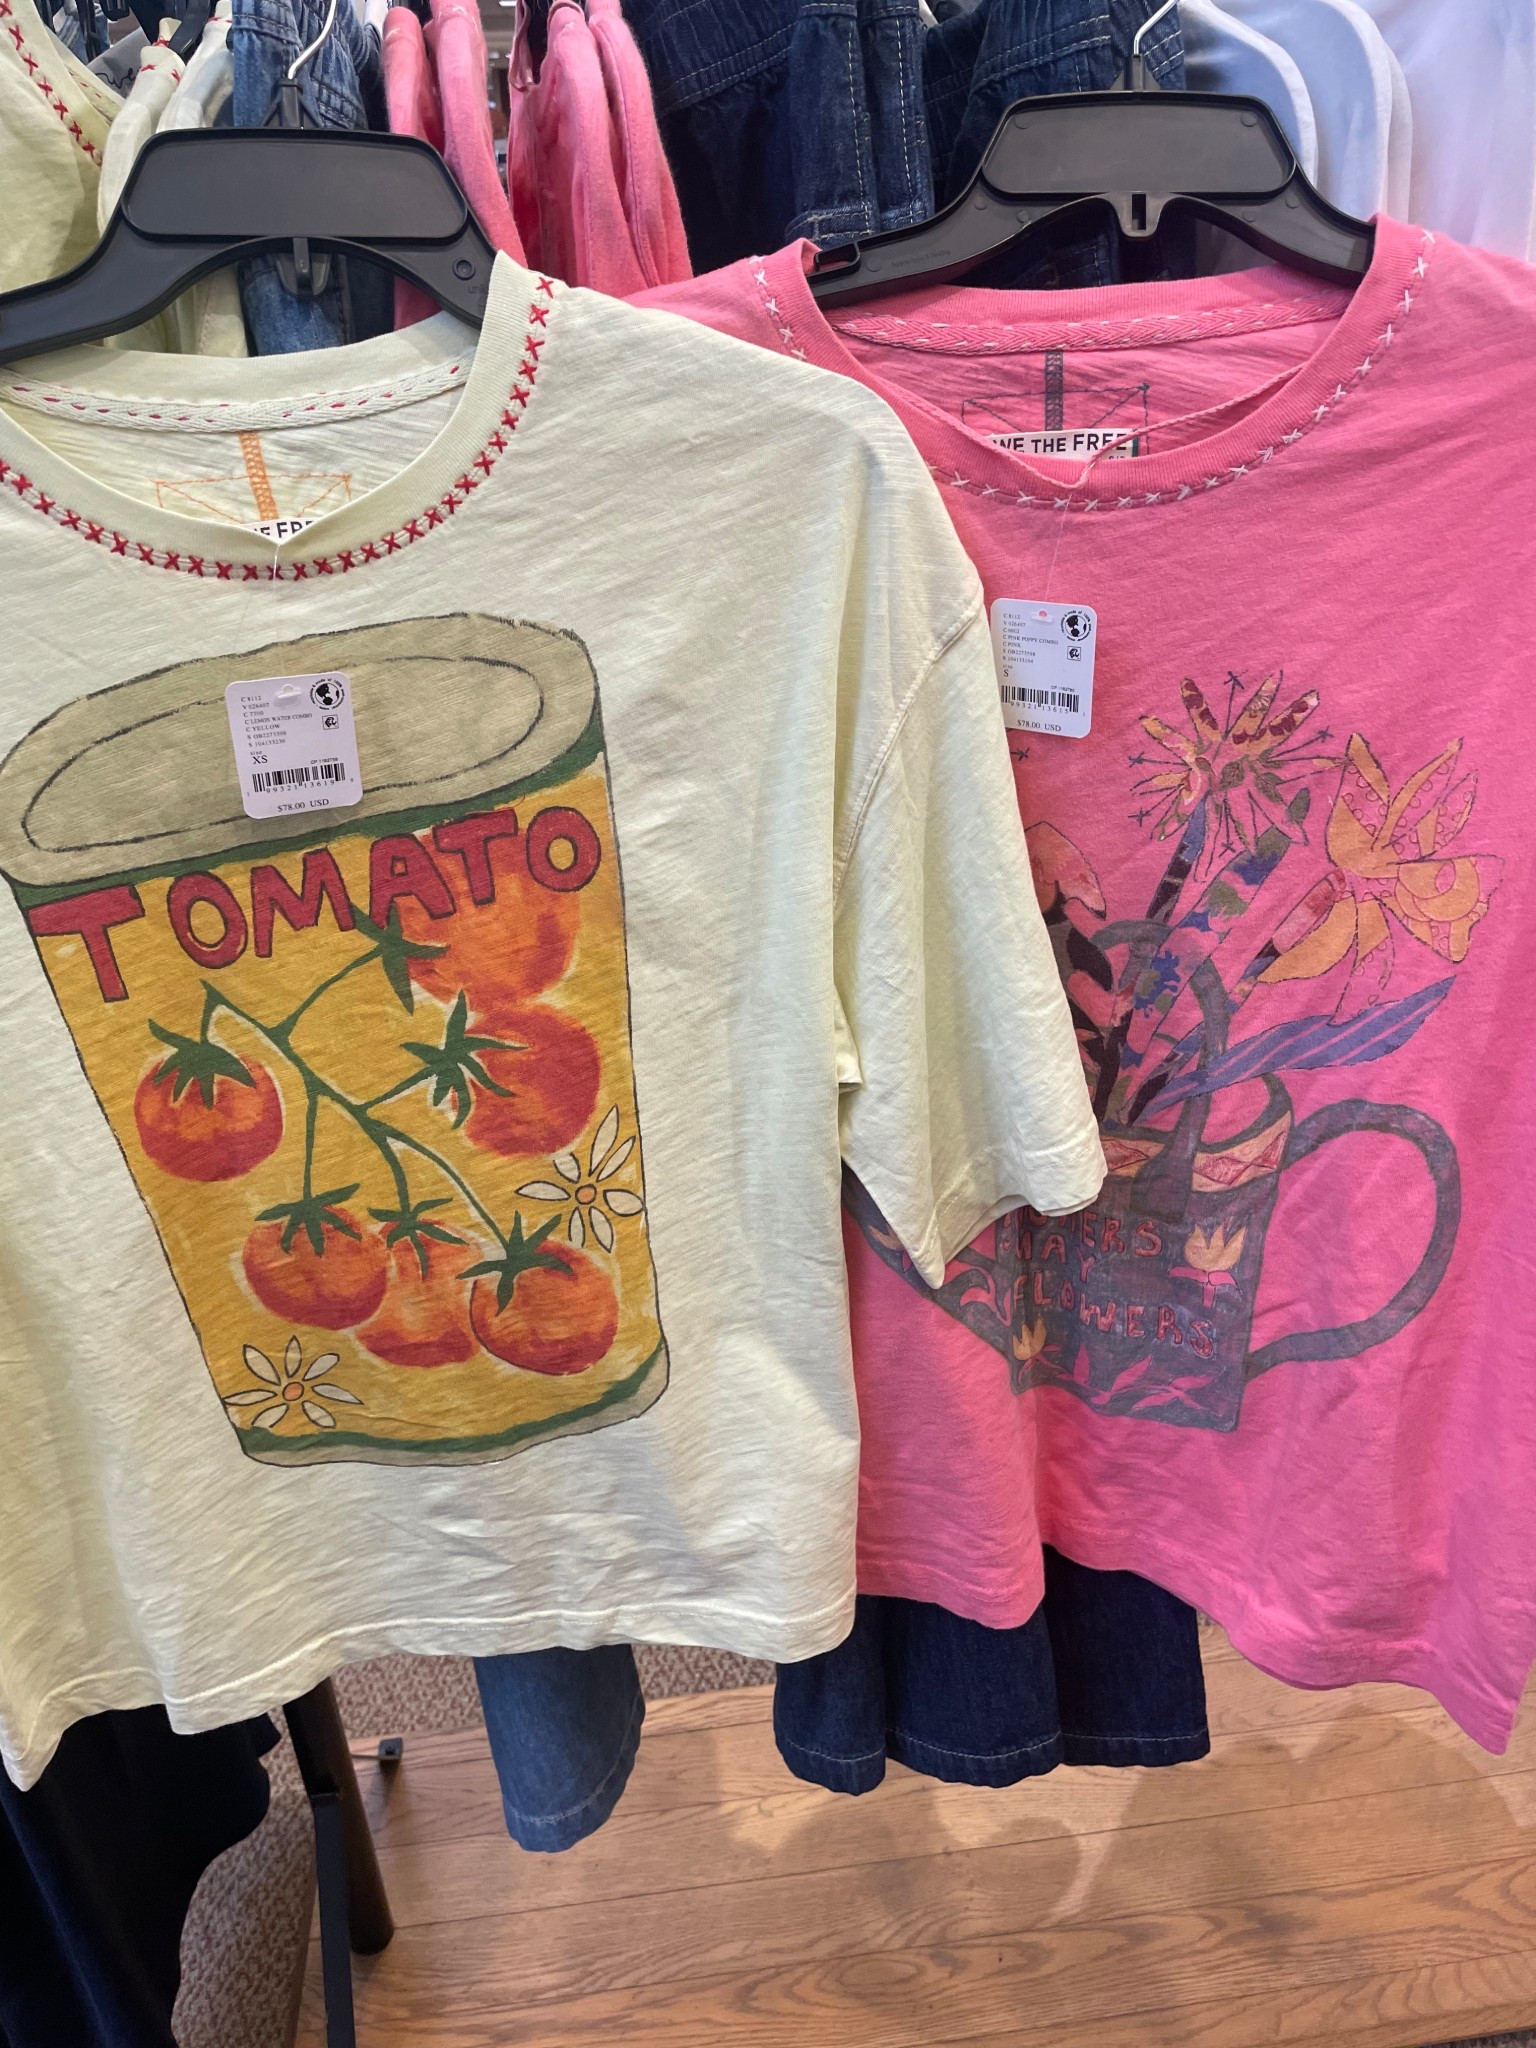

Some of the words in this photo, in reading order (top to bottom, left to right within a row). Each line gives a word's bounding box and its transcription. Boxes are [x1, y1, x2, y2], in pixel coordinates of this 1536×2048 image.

[1031, 437, 1067, 454] THE
[1073, 433, 1128, 452] FREE
[1003, 669, 1009, 677] S
[252, 724, 280, 732] YELLOW
[1017, 720, 1041, 728] $78.00
[1044, 723, 1061, 732] USD
[252, 755, 268, 765] XS
[304, 780, 335, 789] 13619
[277, 802, 305, 812] $78.00
[310, 799, 330, 807] USD
[28, 806, 600, 1003] TOMATO
[1013, 1270, 1215, 1359] FLOWERS
